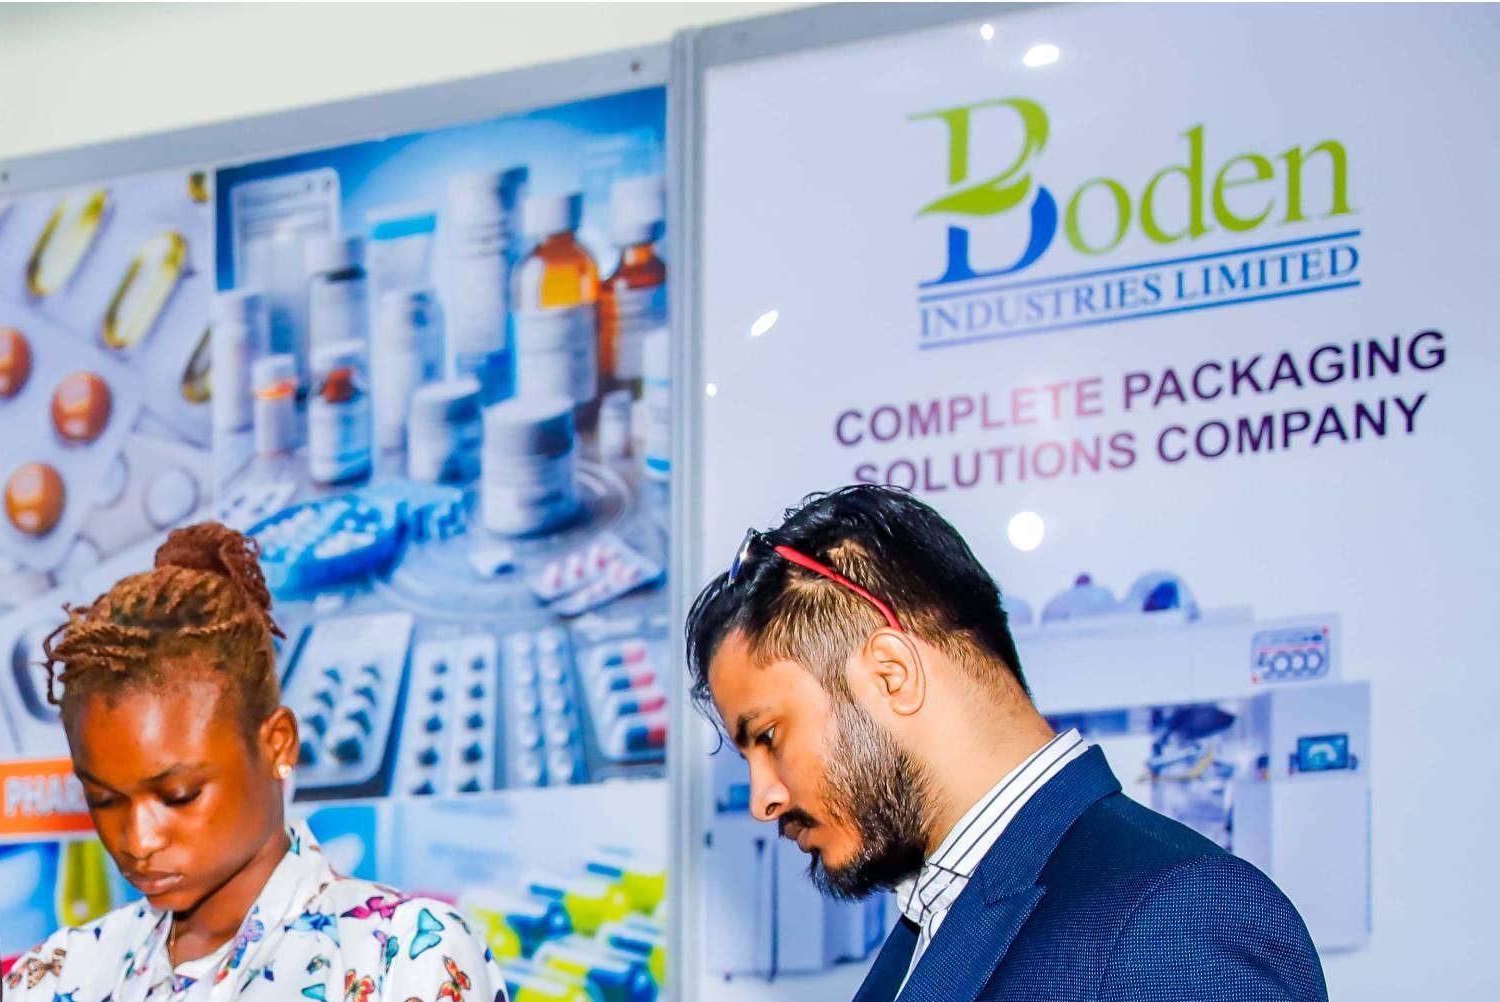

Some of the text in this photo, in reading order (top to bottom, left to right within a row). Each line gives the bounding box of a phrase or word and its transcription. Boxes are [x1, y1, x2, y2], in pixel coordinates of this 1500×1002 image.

[906, 96, 1357, 286] Boden
[919, 245, 1360, 338] INDUSTRIES LIMITED
[835, 329, 1448, 447] COMPLETE PACKAGING
[1156, 394, 1429, 465] COMPANY
